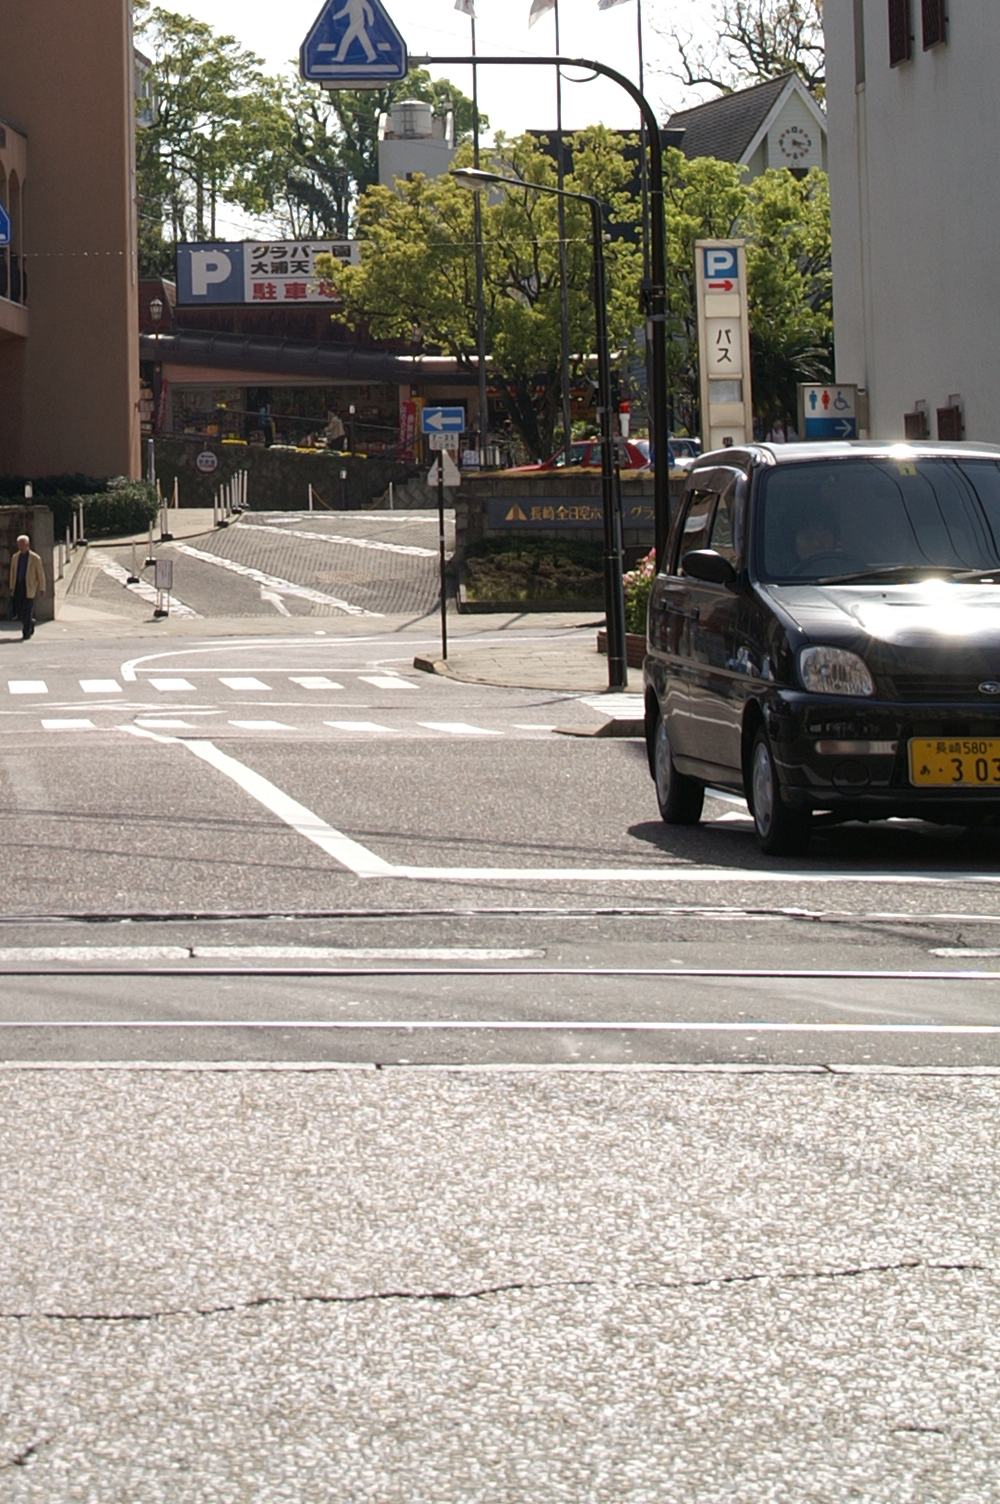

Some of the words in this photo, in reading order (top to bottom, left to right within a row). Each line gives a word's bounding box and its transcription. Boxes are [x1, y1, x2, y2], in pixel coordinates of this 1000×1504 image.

[252, 245, 351, 259] グラバー園
[706, 250, 734, 276] P
[191, 251, 232, 295] P
[251, 260, 351, 275] 大浦天
[716, 328, 732, 363] バス
